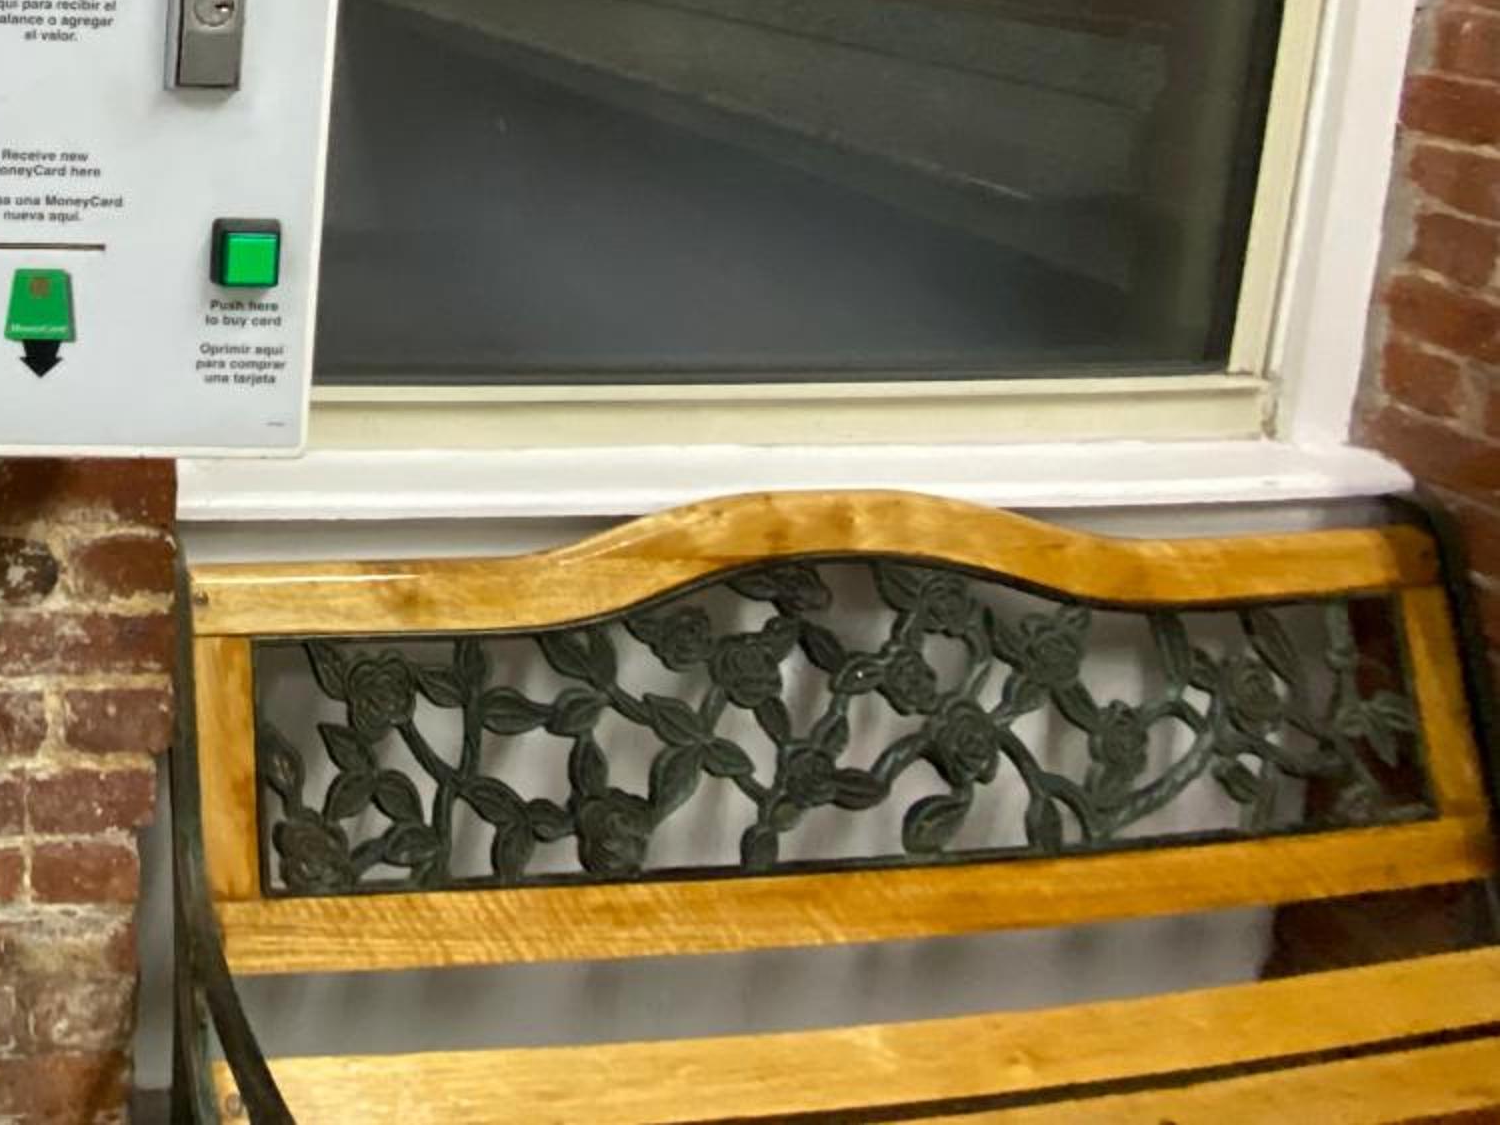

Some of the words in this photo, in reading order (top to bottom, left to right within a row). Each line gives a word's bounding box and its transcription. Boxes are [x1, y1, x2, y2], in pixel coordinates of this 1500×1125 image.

[22, 0, 52, 13] para
[56, 0, 100, 11] recibir
[104, 1, 116, 11] el
[61, 17, 114, 30] agregar
[24, 30, 36, 41] el
[41, 31, 78, 42] valor.
[2, 149, 56, 161] Receive
[60, 152, 89, 161] new
[70, 165, 101, 177] here
[15, 196, 40, 206] una
[45, 194, 123, 209] MoneyCard
[4, 210, 45, 221] nueva
[210, 299, 244, 311] Push
[248, 300, 279, 312] here
[205, 315, 218, 326] to
[222, 314, 247, 328] buy
[251, 315, 281, 326] card
[199, 343, 251, 355] Oprimir
[196, 360, 226, 371] para
[229, 360, 286, 372] comprar
[204, 374, 229, 384] una
[233, 374, 276, 387] tarjeta
